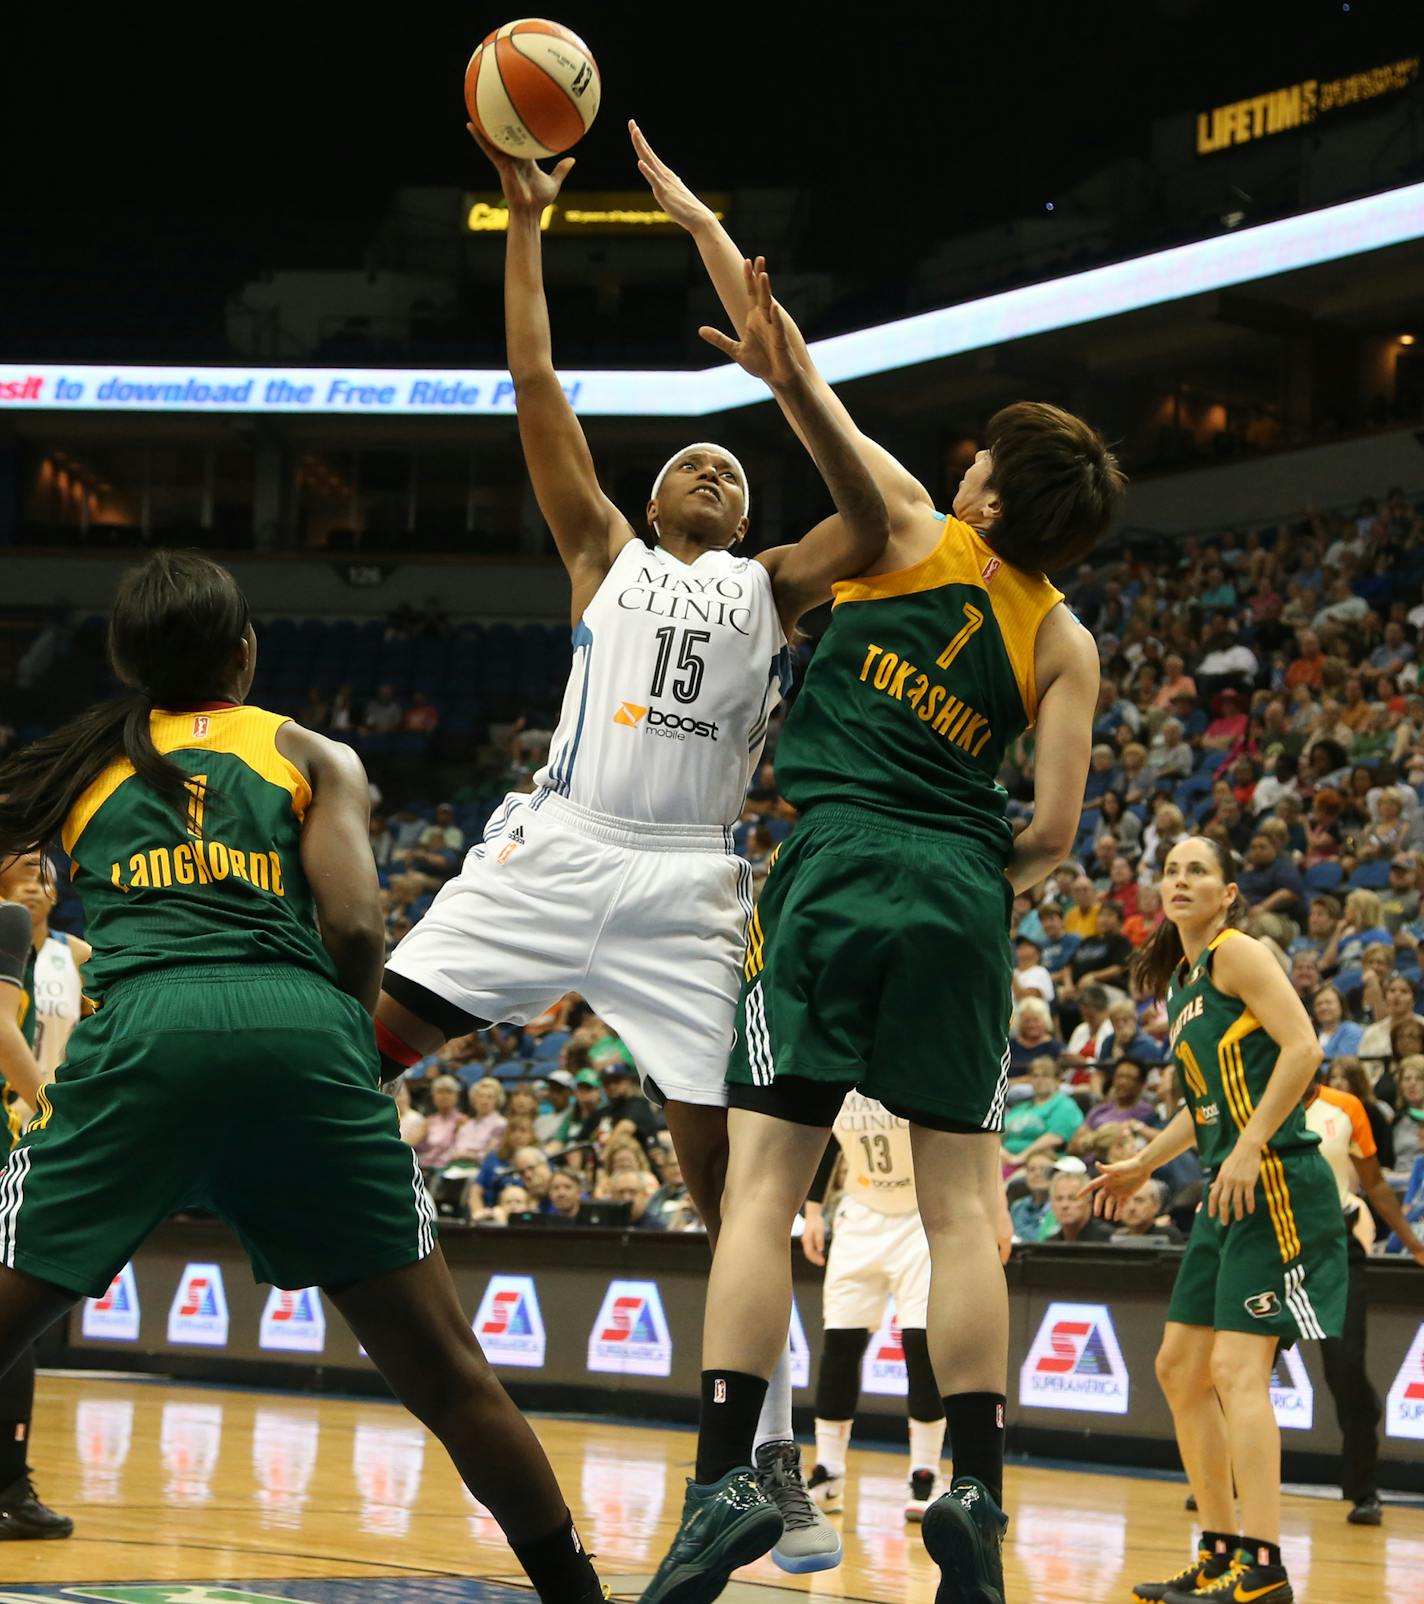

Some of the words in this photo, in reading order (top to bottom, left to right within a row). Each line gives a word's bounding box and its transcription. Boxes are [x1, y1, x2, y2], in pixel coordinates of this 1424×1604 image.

[0, 376, 44, 401] sit
[54, 377, 84, 400] to
[97, 377, 255, 403] download
[264, 379, 315, 404] the
[326, 379, 398, 405] Free
[408, 380, 480, 406] Ride
[634, 566, 744, 600] MAYO
[617, 587, 751, 636] CLINIC
[935, 602, 984, 671] 7
[650, 625, 711, 704] 15
[645, 725, 686, 741] mobile
[647, 706, 719, 741] boost
[859, 1134, 894, 1175] 13
